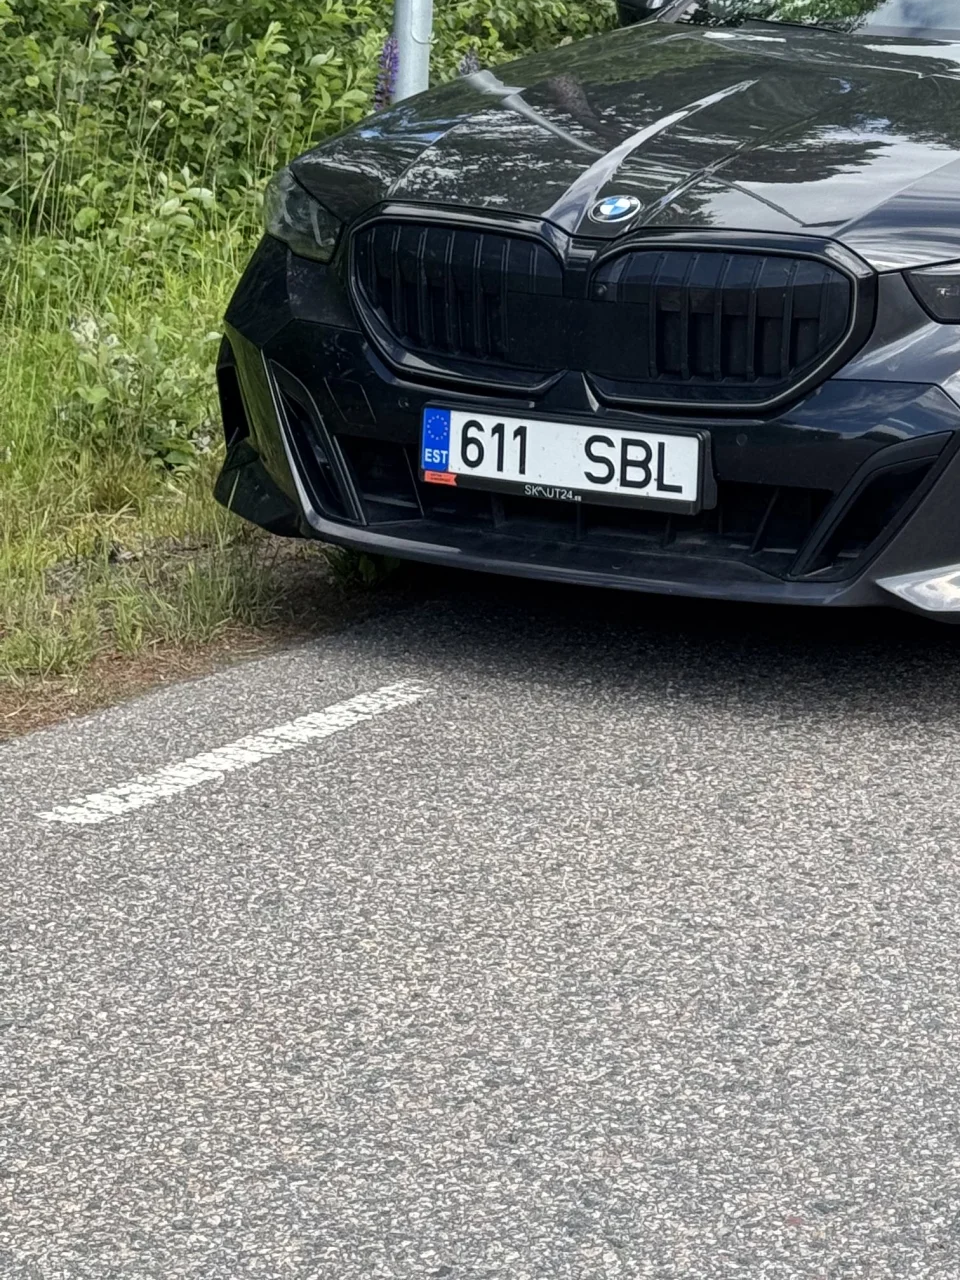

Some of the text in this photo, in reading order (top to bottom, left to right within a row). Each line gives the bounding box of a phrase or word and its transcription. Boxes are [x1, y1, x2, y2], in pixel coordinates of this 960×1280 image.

[425, 448, 448, 464] EST
[460, 419, 683, 493] 611 SBL
